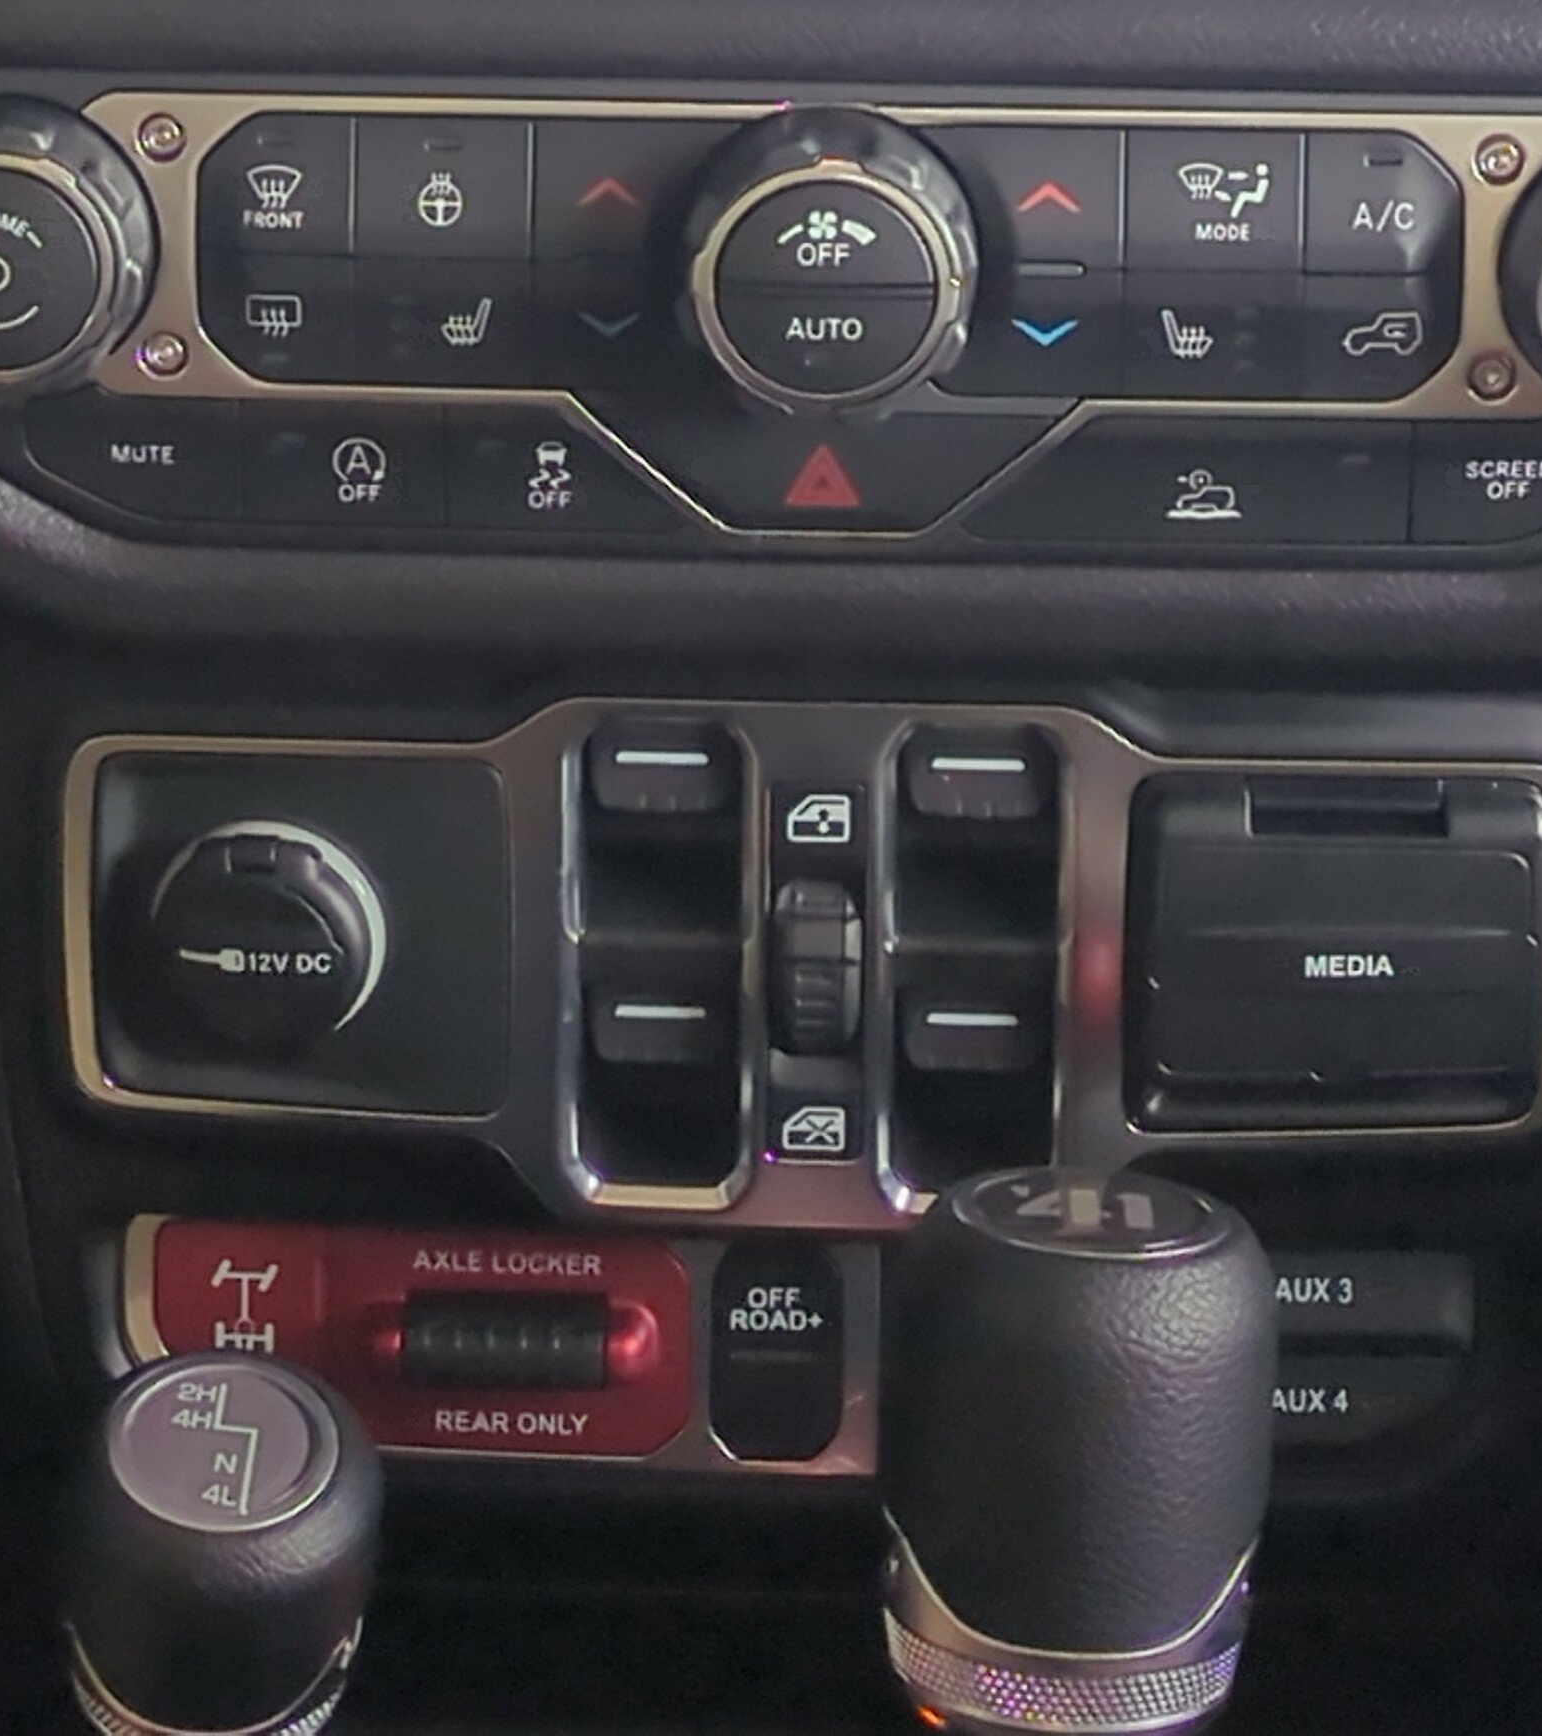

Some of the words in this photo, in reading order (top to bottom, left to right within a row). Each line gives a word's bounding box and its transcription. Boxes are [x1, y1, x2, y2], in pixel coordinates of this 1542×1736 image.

[243, 211, 304, 229] FRONT
[1353, 202, 1415, 230] A/C
[1195, 223, 1250, 242] MODE
[796, 243, 850, 267] OFF
[786, 318, 863, 340] AUTO
[111, 445, 175, 464] MUTE
[338, 483, 382, 503] OFF
[528, 490, 572, 509] OFF
[1487, 481, 1531, 501] OFF
[248, 952, 289, 975] 12V
[296, 953, 332, 975] DC
[1304, 954, 1394, 978] MEDIA
[413, 1250, 482, 1273] AXLE
[492, 1252, 603, 1276] LOCKER
[747, 1286, 801, 1310] OFF
[1275, 1277, 1331, 1305] AUX
[1338, 1277, 1355, 1305] 3
[178, 1382, 216, 1404] 2H
[1272, 1388, 1326, 1414] AUX
[1332, 1388, 1350, 1415] 4
[171, 1408, 213, 1430] 4H
[435, 1409, 509, 1434] REAR
[518, 1411, 590, 1436] ONLY
[213, 1453, 237, 1471] N
[201, 1484, 237, 1506] 4L
